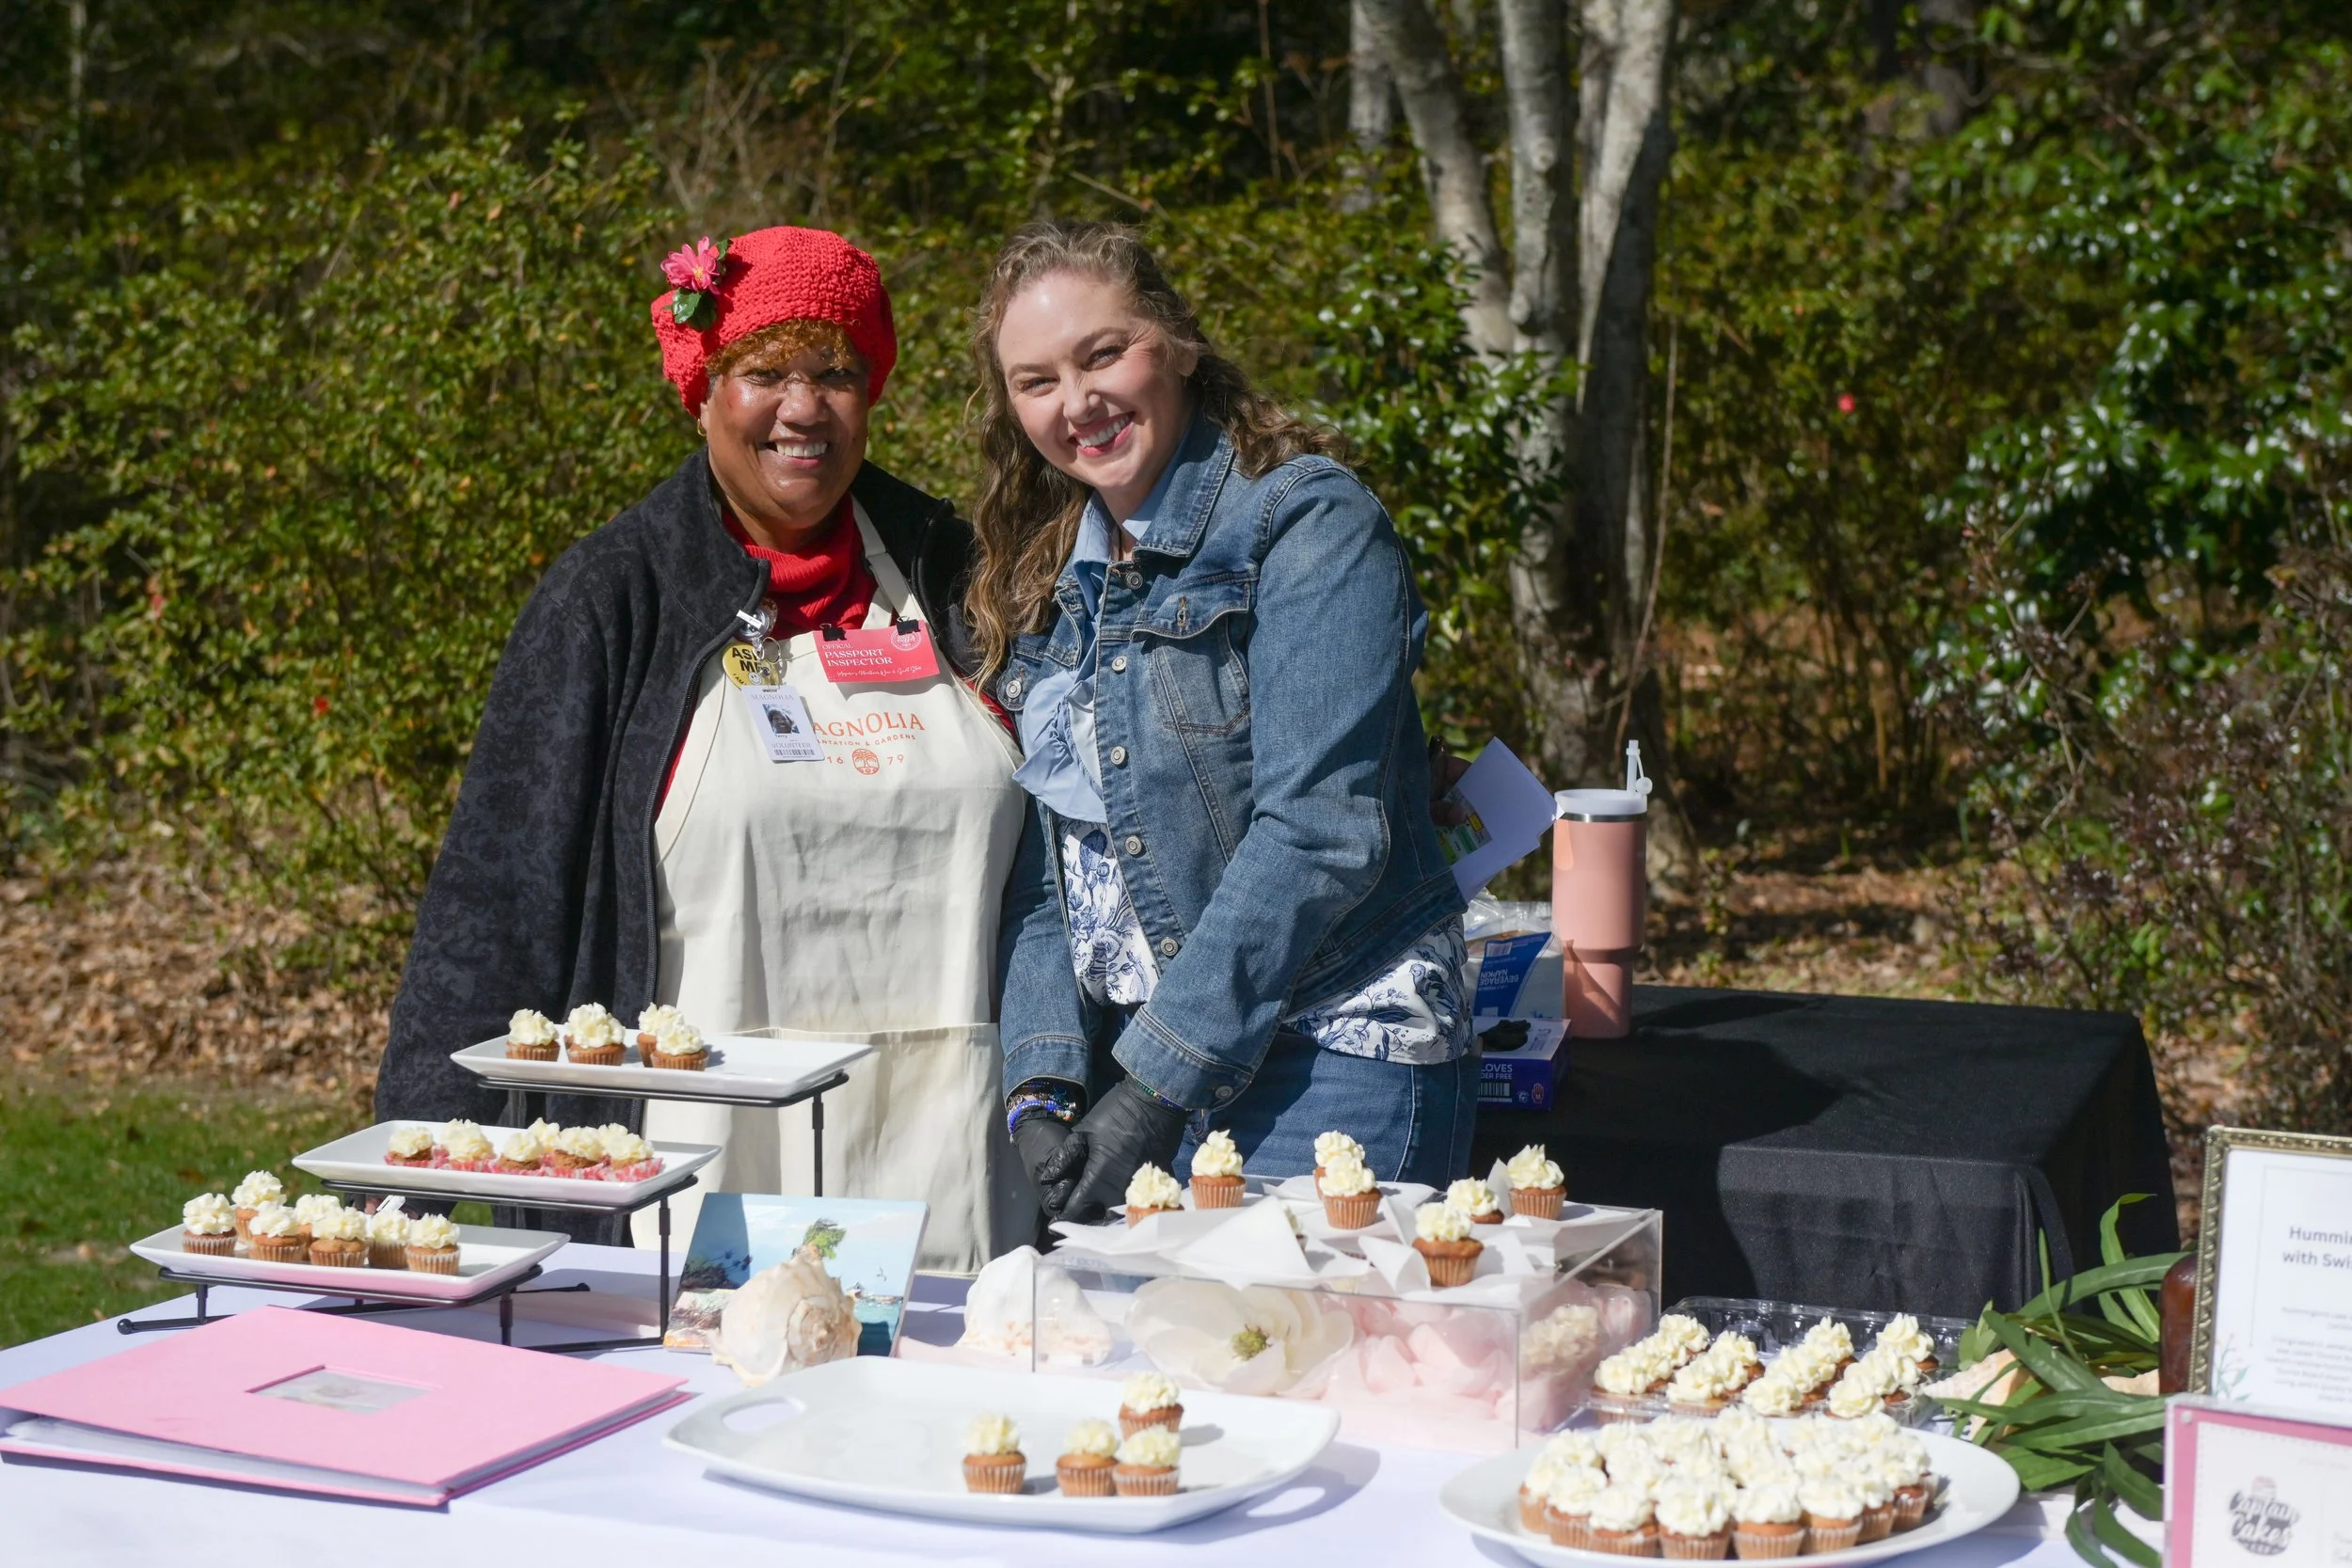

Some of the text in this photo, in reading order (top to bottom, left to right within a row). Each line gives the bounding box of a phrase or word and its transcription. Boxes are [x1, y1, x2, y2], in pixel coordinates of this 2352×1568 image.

[825, 648, 884, 658] PASSPORT
[828, 657, 893, 667] INSPECTOR
[813, 712, 925, 736] AGNOLIA
[874, 734, 916, 746] GARDENS
[1480, 968, 1508, 978] NAPKIN
[1479, 974, 1518, 986] BEVERAGE
[1482, 1063, 1513, 1072] OVES
[2282, 1250, 2352, 1270] with Swi
